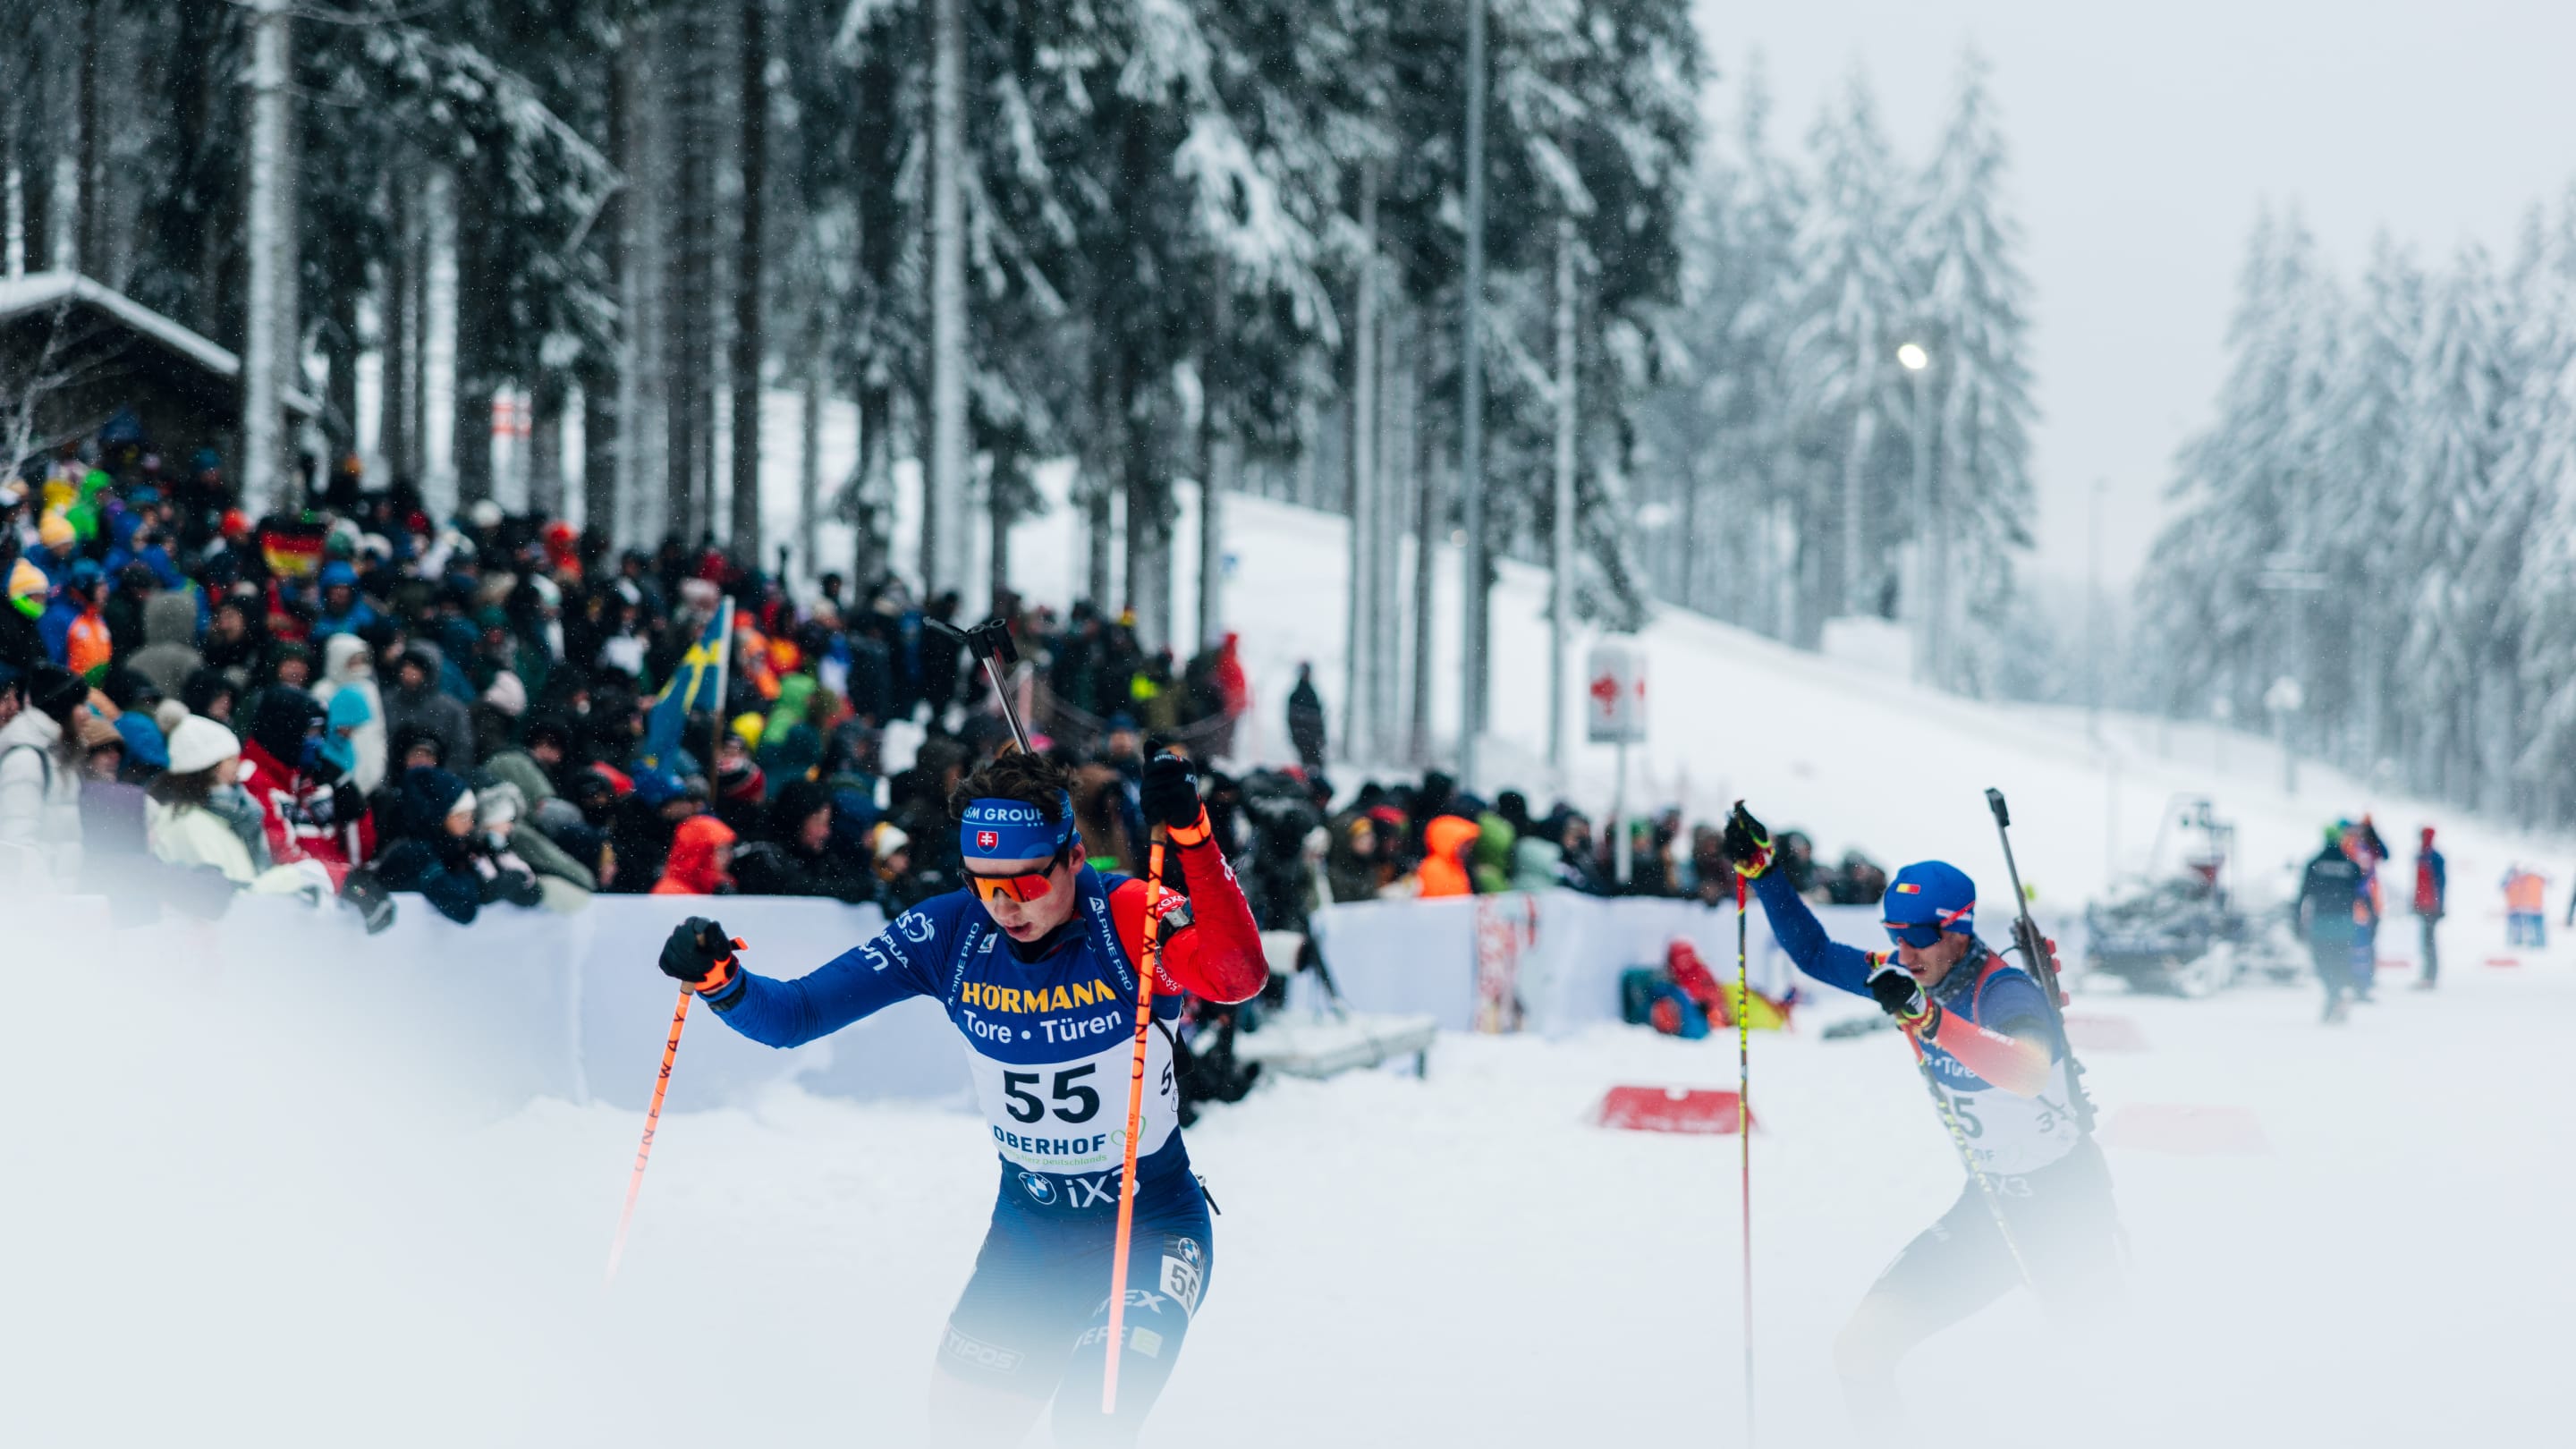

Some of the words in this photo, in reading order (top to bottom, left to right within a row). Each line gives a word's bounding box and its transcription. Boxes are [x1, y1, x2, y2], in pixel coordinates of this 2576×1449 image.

[961, 922, 980, 958] PRO
[1089, 896, 1118, 957] ALPINE
[1113, 959, 1134, 992] PRO
[962, 979, 1116, 1013] HÖRMANN
[962, 1009, 1013, 1044] Tore
[1039, 1010, 1122, 1044] Türen
[1003, 1063, 1100, 1123] 55
[1953, 1096, 1983, 1139] 5
[994, 1124, 1106, 1156] OBERHOF
[1043, 1153, 1107, 1166] Deutschlands
[1170, 1263, 1198, 1311] 55
